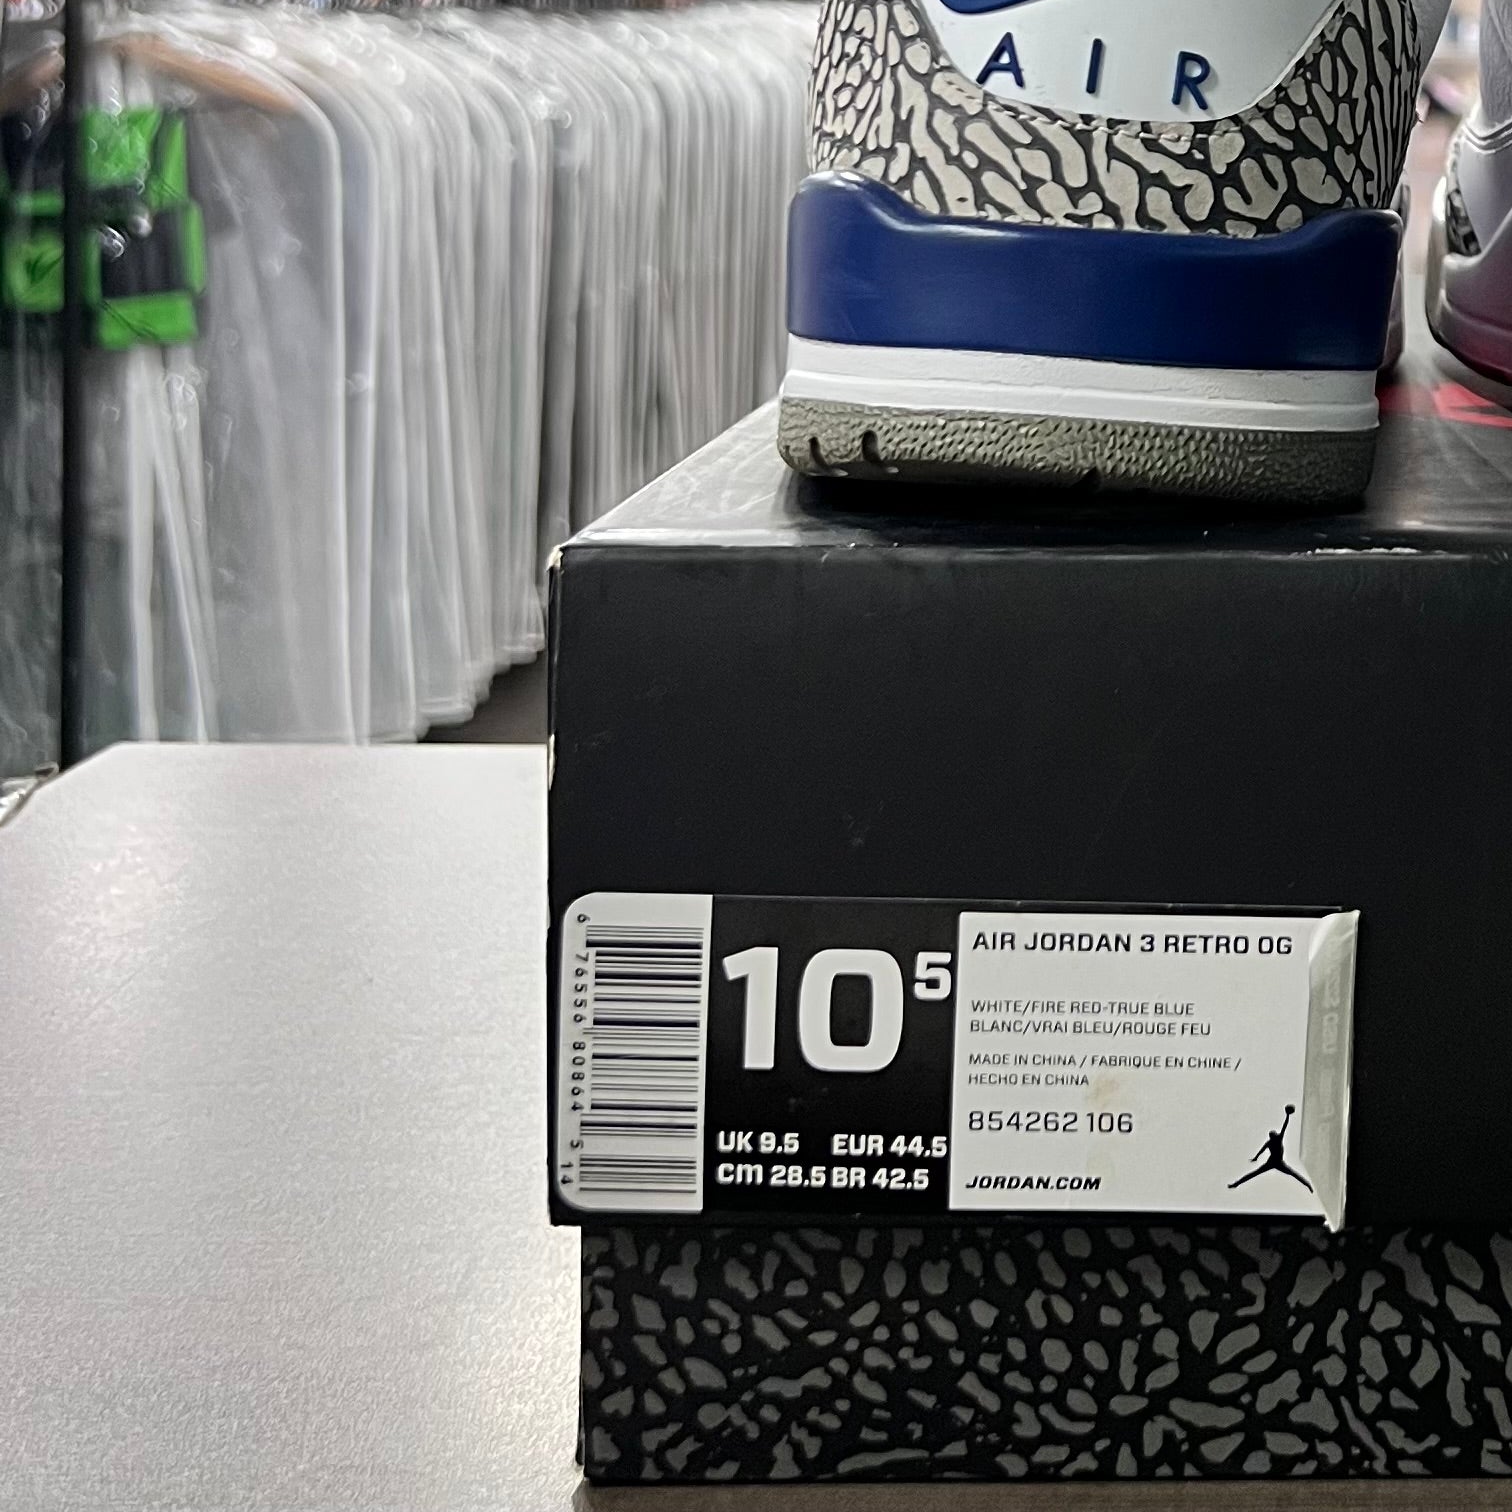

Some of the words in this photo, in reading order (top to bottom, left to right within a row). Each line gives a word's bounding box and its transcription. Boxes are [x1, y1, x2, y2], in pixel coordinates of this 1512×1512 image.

[976, 32, 1212, 111] AIR
[972, 932, 1017, 952] AIR
[1024, 932, 1132, 953] JORDAN
[1140, 934, 1155, 953] 3
[1164, 935, 1250, 955] RETRO
[1258, 936, 1293, 955] OG
[573, 952, 589, 1024] 76556
[971, 1000, 1066, 1016] WHITE/FIRE
[1070, 1001, 1150, 1016] RED-TRUE
[1154, 1003, 1195, 1017] BLUE
[970, 1020, 1068, 1034] BLANC/VRAI
[1073, 1021, 1177, 1037] BLEU/ROUGE
[1181, 1023, 1211, 1037] FEU
[968, 1054, 1010, 1067] MADE
[1014, 1054, 1028, 1067] IN
[1032, 1055, 1077, 1067] CHINA
[1091, 1055, 1162, 1070] FABRIQUE
[1165, 1056, 1184, 1069] EN
[1188, 1057, 1232, 1070] CHINE
[571, 1040, 586, 1112] 80864
[968, 1073, 1018, 1086] HECHO
[1022, 1073, 1041, 1086] EN
[1045, 1073, 1090, 1086] CHINA
[717, 1131, 754, 1154] UK
[760, 1132, 800, 1155] 9.5
[832, 1134, 884, 1156] EUR
[889, 1135, 948, 1158] 44.5
[560, 1162, 575, 1186] 14
[769, 1165, 827, 1188] 28.5
[832, 1166, 866, 1189] BR
[871, 1168, 930, 1190] 42.5
[965, 1175, 1102, 1190] JORDAN.COM
